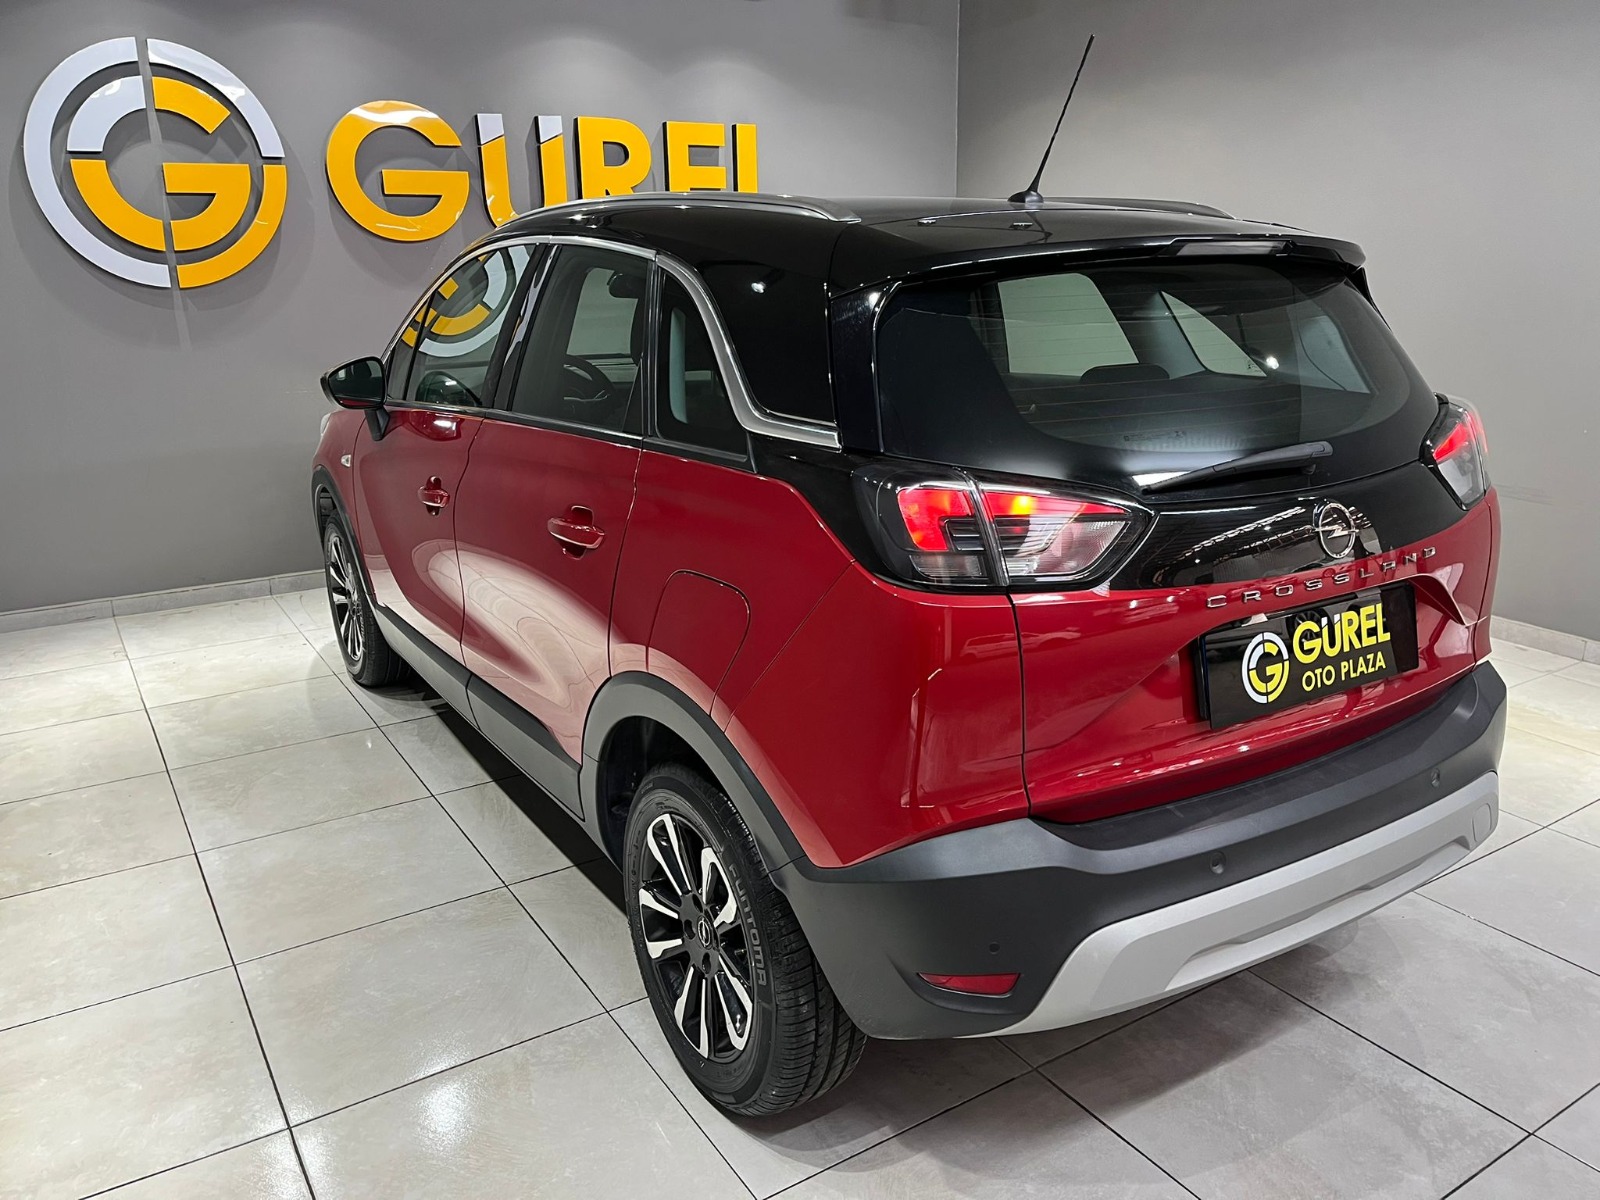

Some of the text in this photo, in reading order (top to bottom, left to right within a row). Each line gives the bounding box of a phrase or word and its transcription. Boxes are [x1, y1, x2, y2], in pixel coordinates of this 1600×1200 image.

[1206, 546, 1436, 608] CROSSLAND
[1301, 651, 1387, 692] OTO PLAZA
